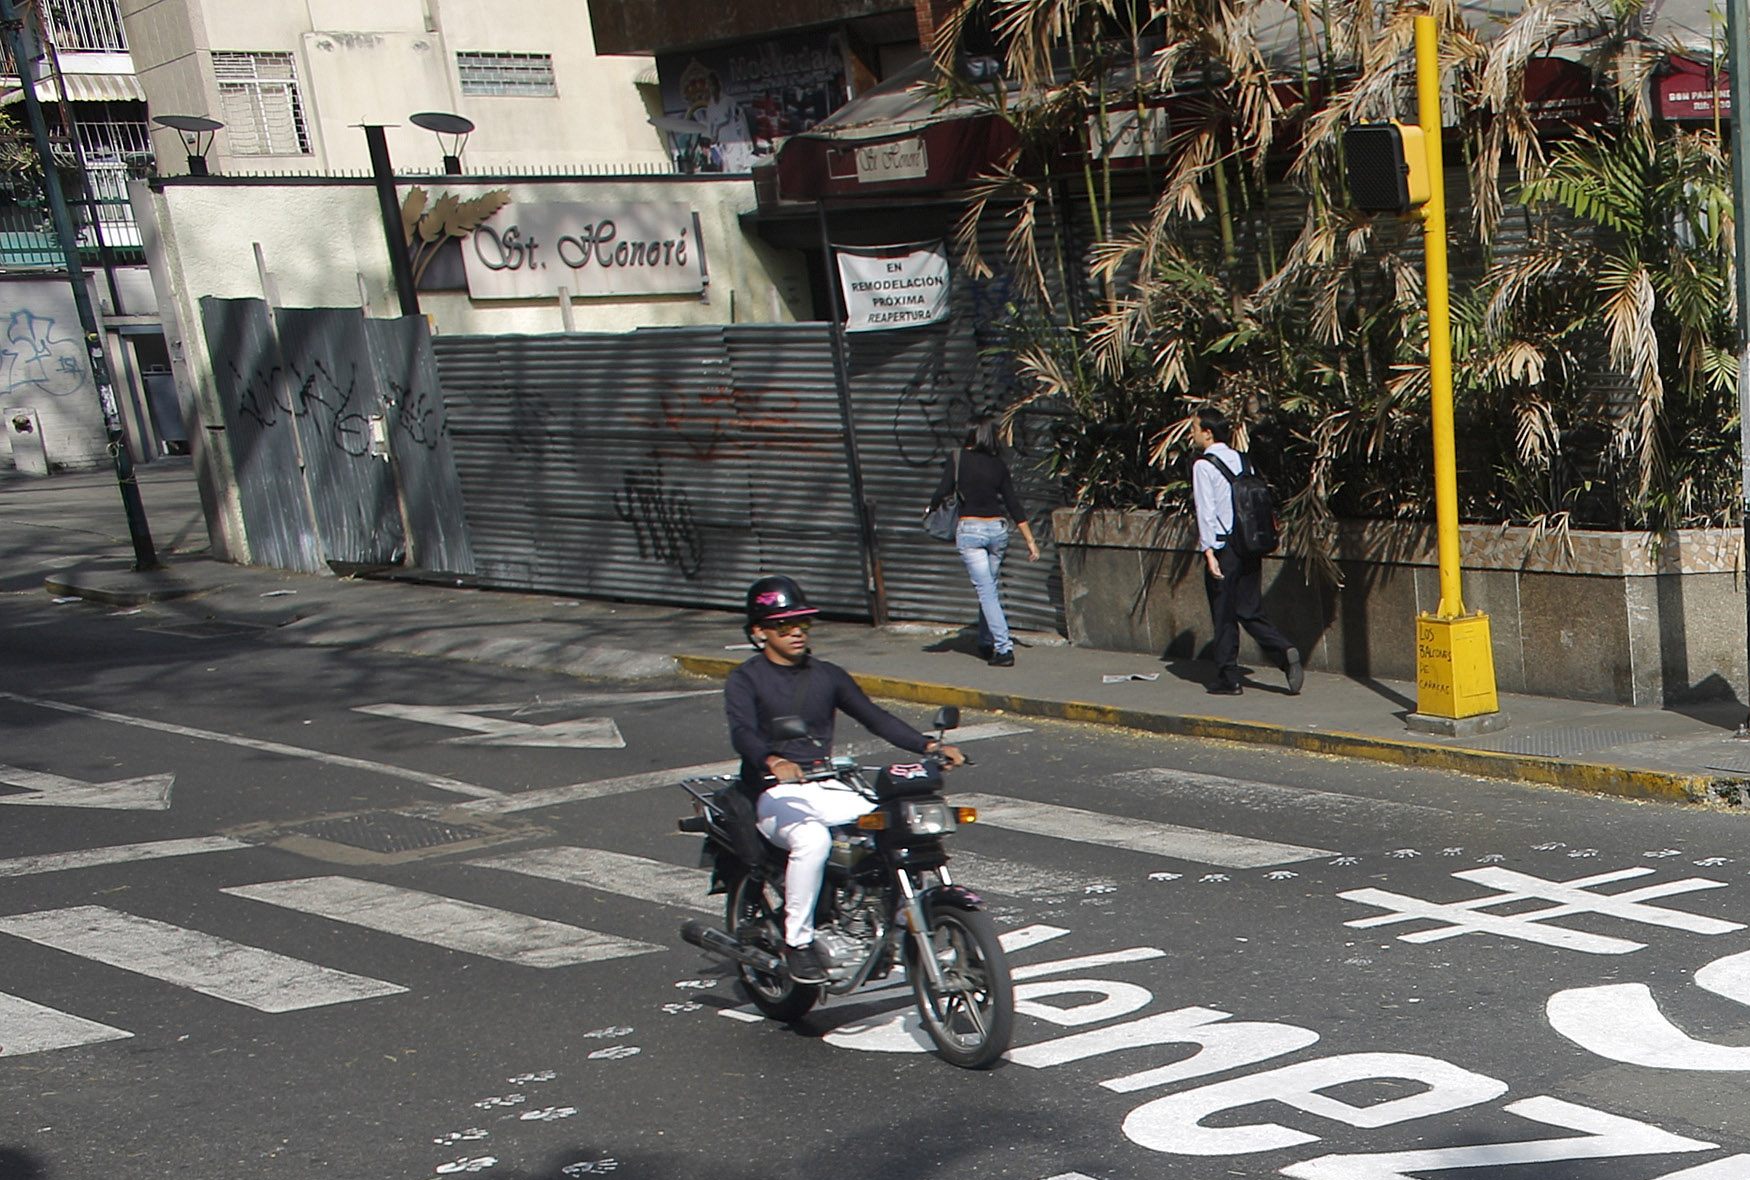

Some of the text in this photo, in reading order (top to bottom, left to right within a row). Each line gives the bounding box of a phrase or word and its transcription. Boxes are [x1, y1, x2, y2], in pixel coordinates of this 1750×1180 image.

[474, 219, 688, 271] St. Honoré
[886, 262, 903, 273] EN
[851, 276, 944, 292] REMODELACIÓN
[872, 295, 925, 307] PRÓXIMA
[867, 309, 933, 323] REAPERTURA
